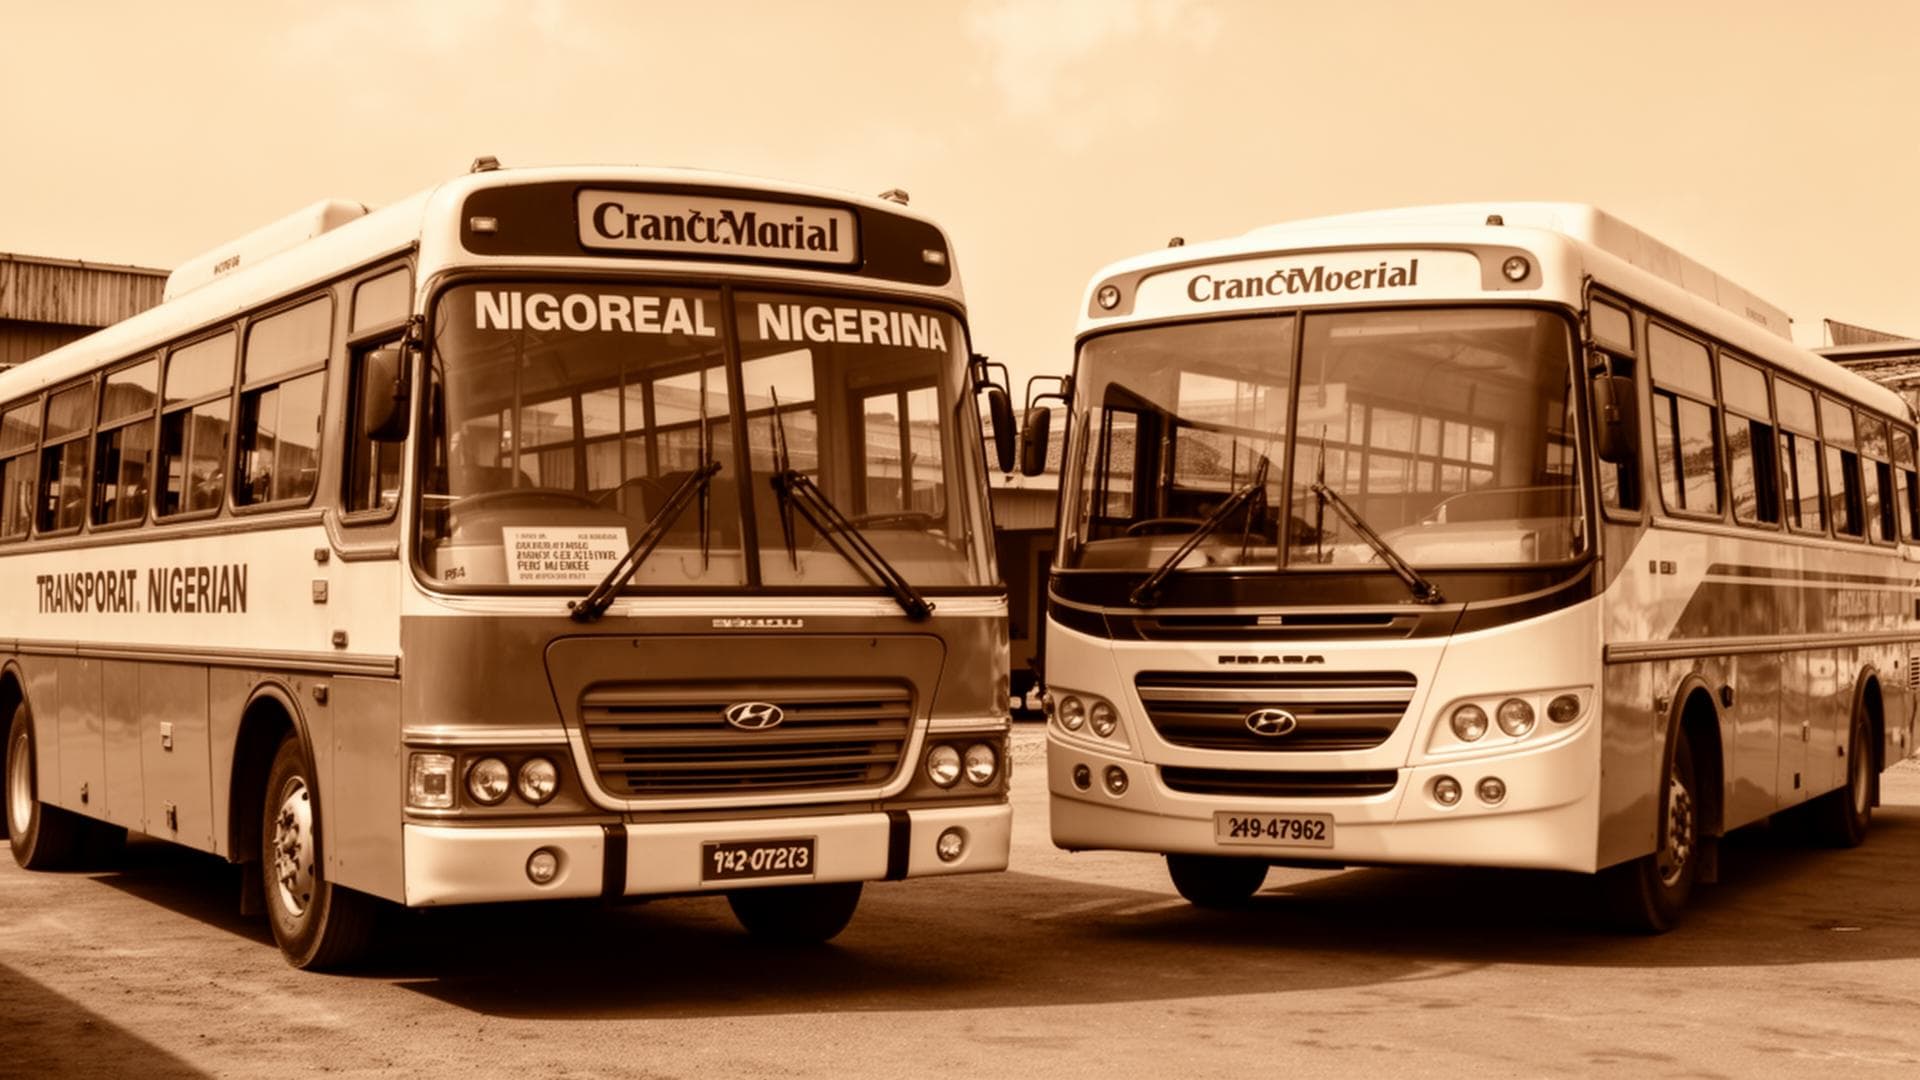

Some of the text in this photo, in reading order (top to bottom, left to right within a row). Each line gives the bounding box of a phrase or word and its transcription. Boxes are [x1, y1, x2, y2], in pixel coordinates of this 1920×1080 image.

[475, 291, 948, 352] NIGOREAL NIGERINA
[148, 563, 248, 613] NIGERIAN
